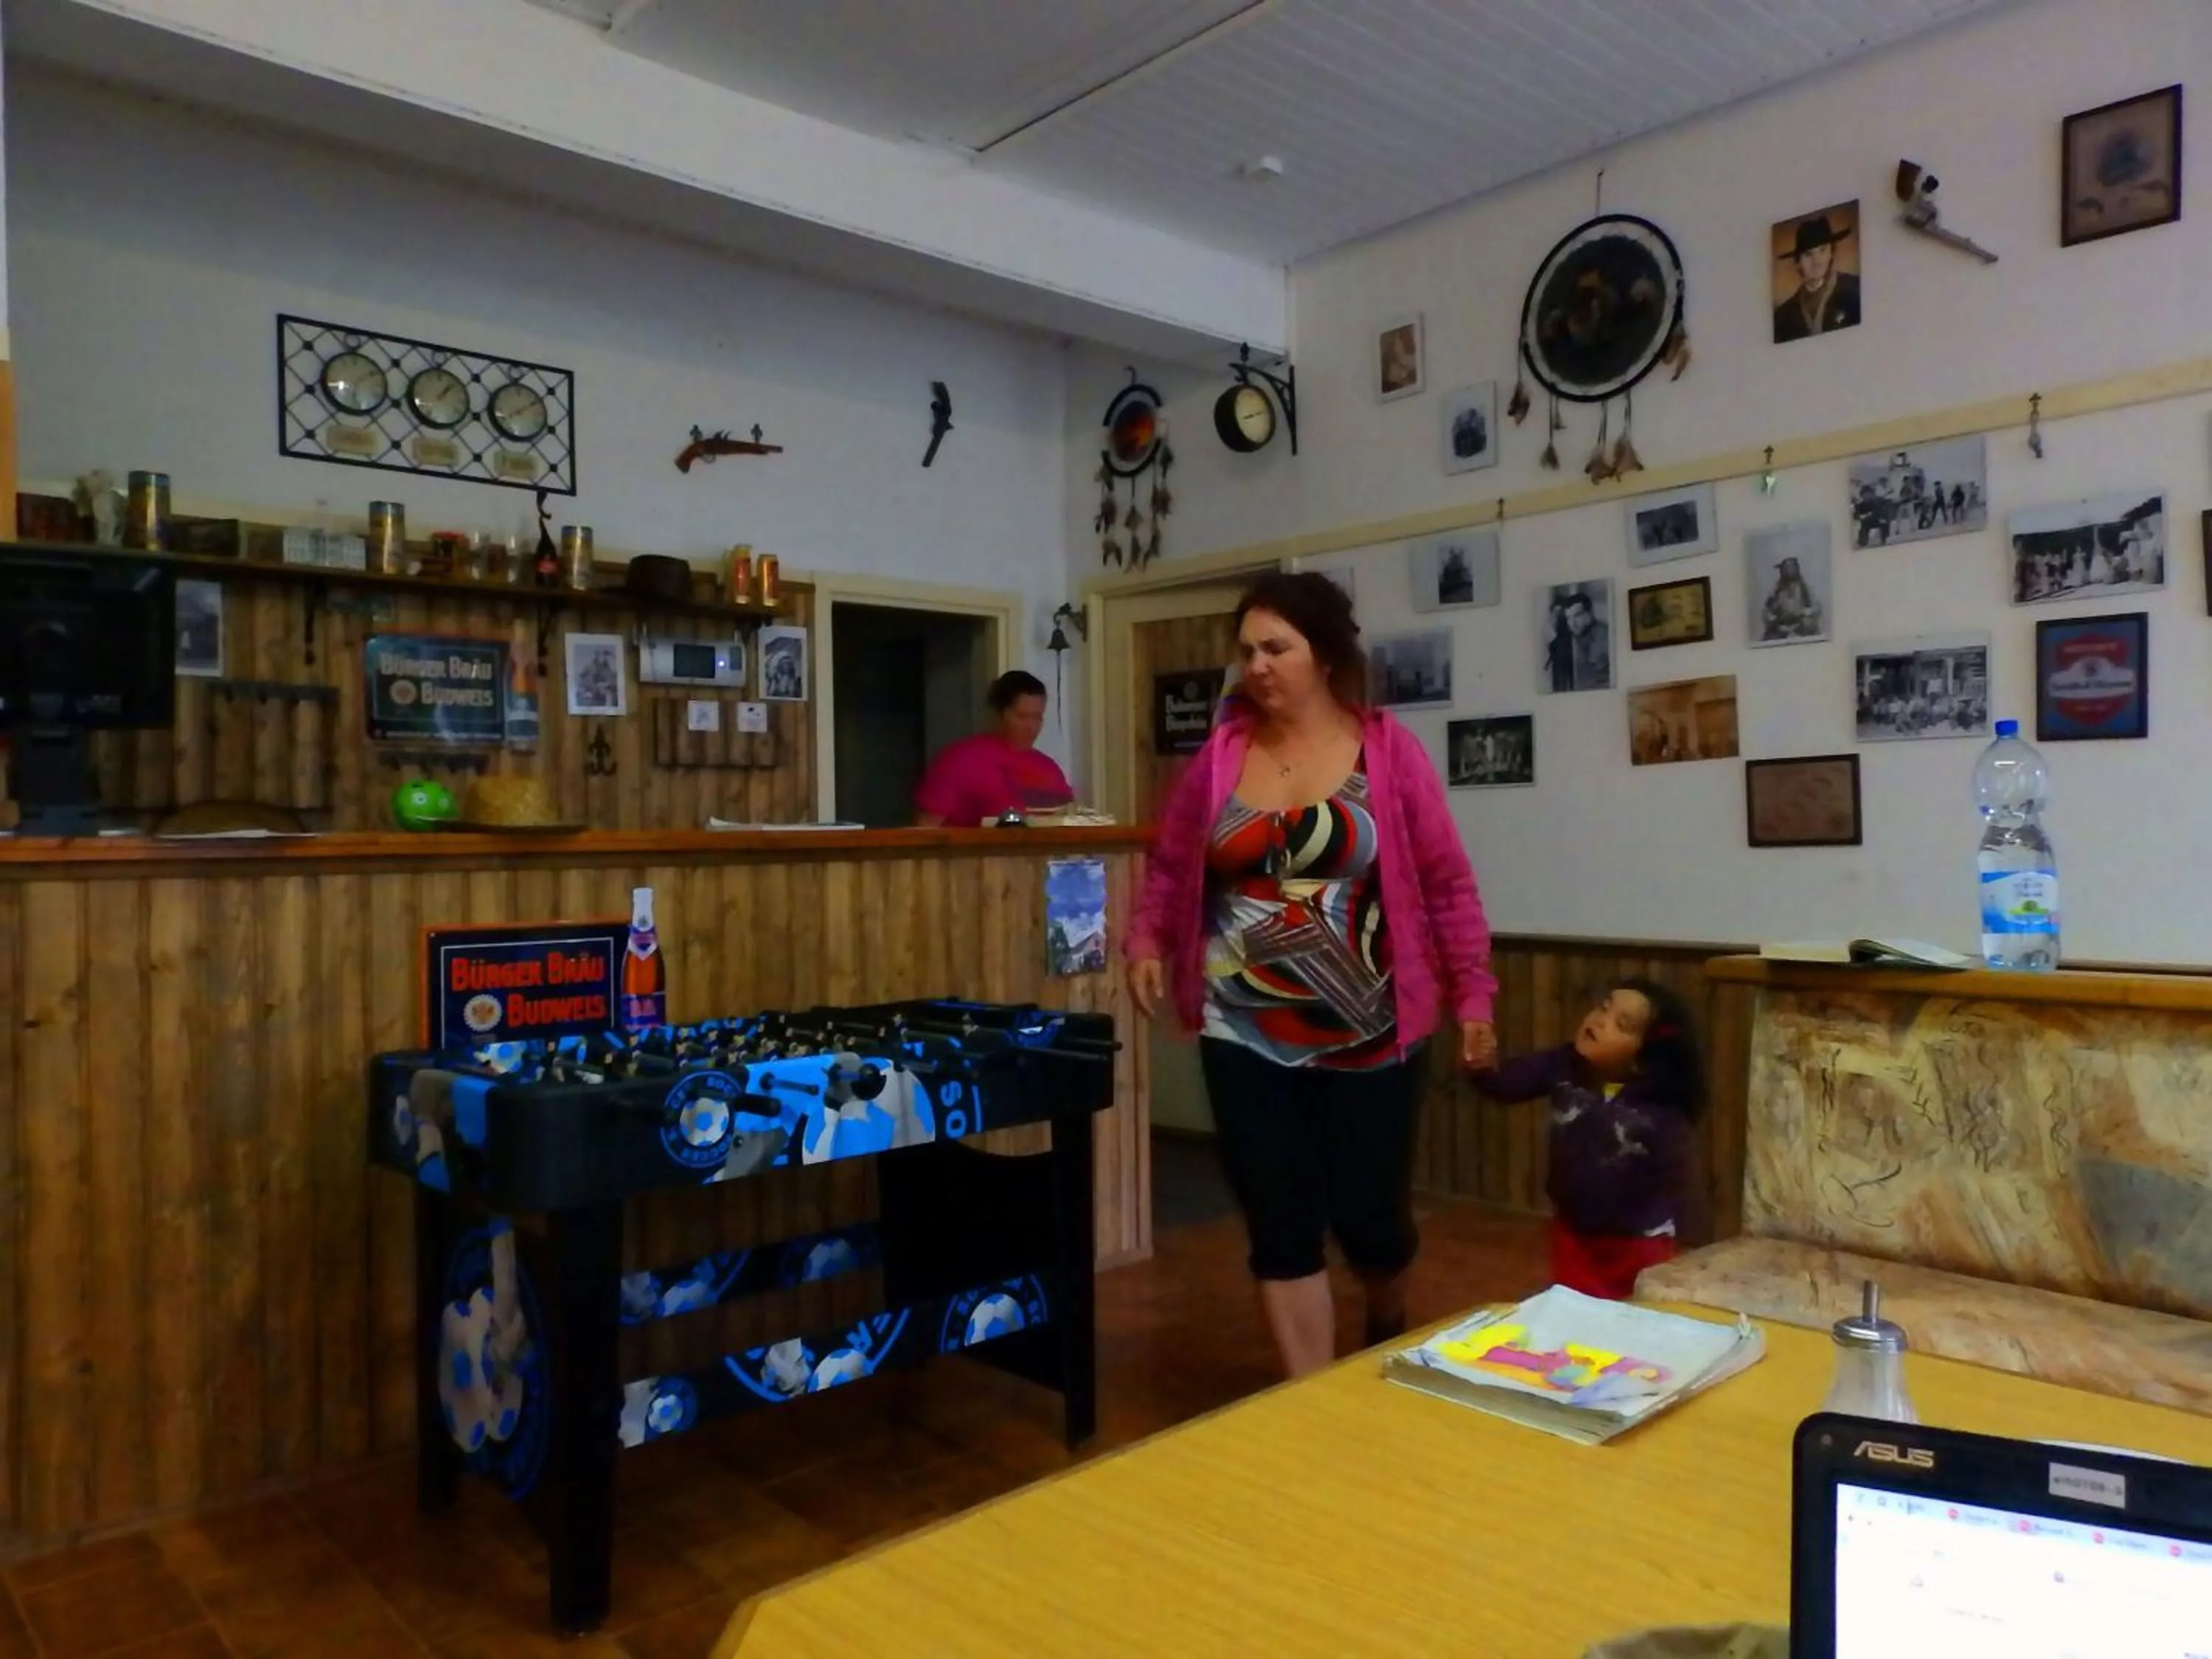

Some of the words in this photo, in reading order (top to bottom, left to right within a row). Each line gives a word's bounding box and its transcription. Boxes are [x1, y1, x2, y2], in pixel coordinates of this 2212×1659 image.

[451, 957, 543, 991] BÜRGER
[548, 951, 604, 984] BRÄU
[507, 993, 606, 1028] BUDWEIS
[1853, 1440, 1935, 1469] ASUS
